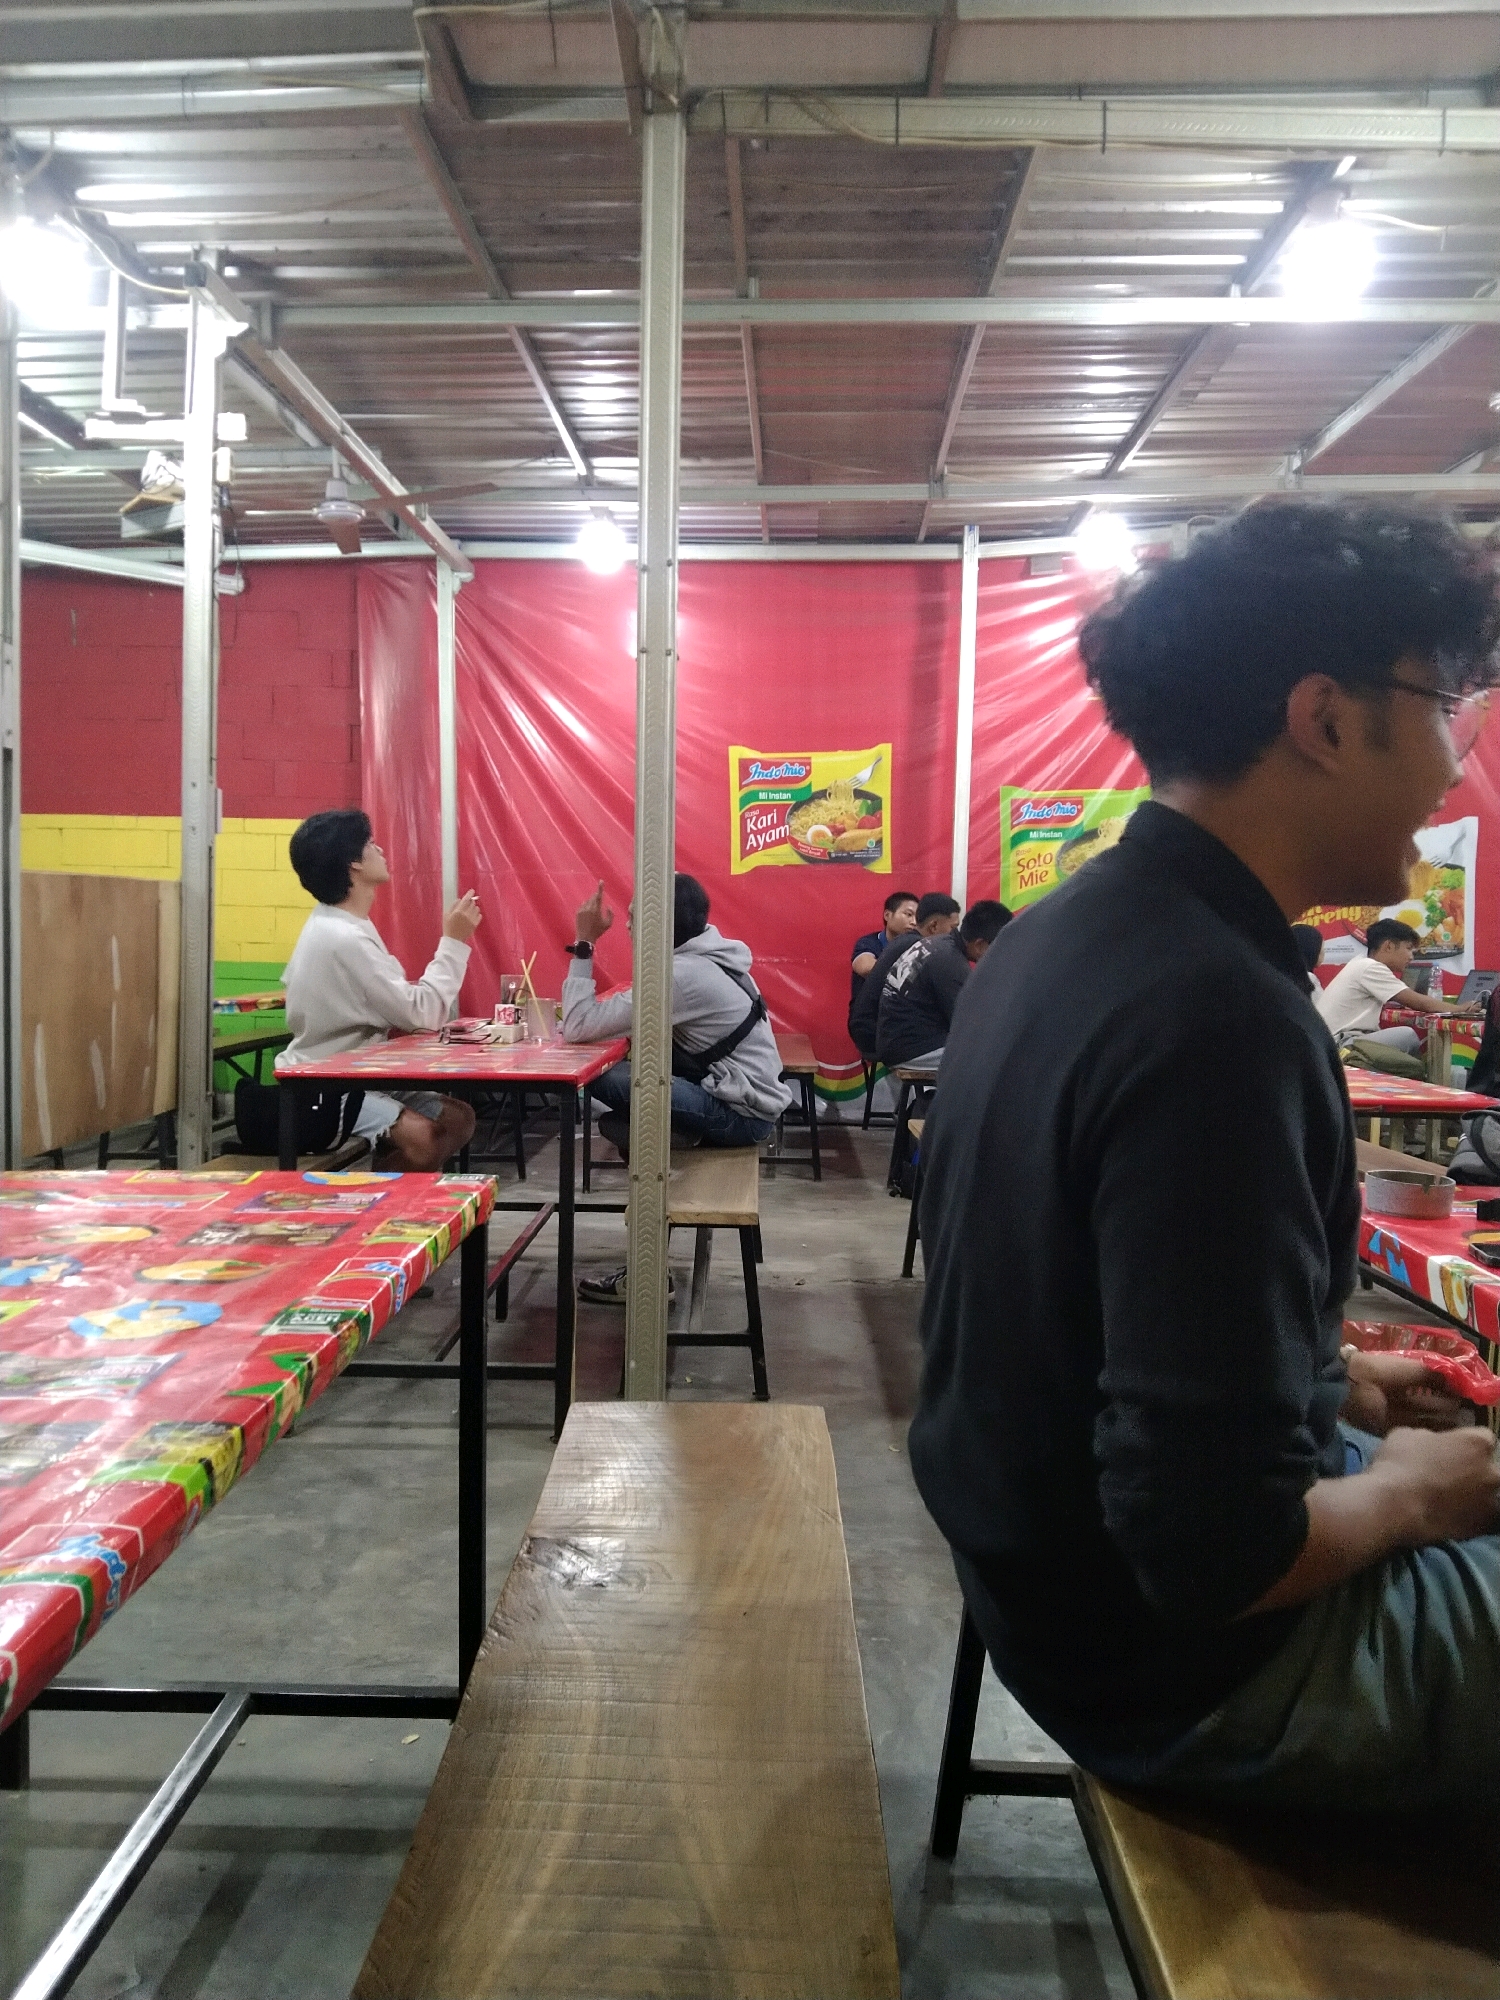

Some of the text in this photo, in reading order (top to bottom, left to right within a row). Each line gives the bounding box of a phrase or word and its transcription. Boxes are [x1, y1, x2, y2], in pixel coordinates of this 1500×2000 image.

[759, 792, 791, 800] Mi Instan
[745, 809, 759, 818] Rasa
[747, 808, 777, 833] Kari
[746, 824, 790, 851] Ayam
[1029, 830, 1063, 839] Mi Instan
[1016, 852, 1053, 875] Soto
[1019, 869, 1049, 890] Mie
